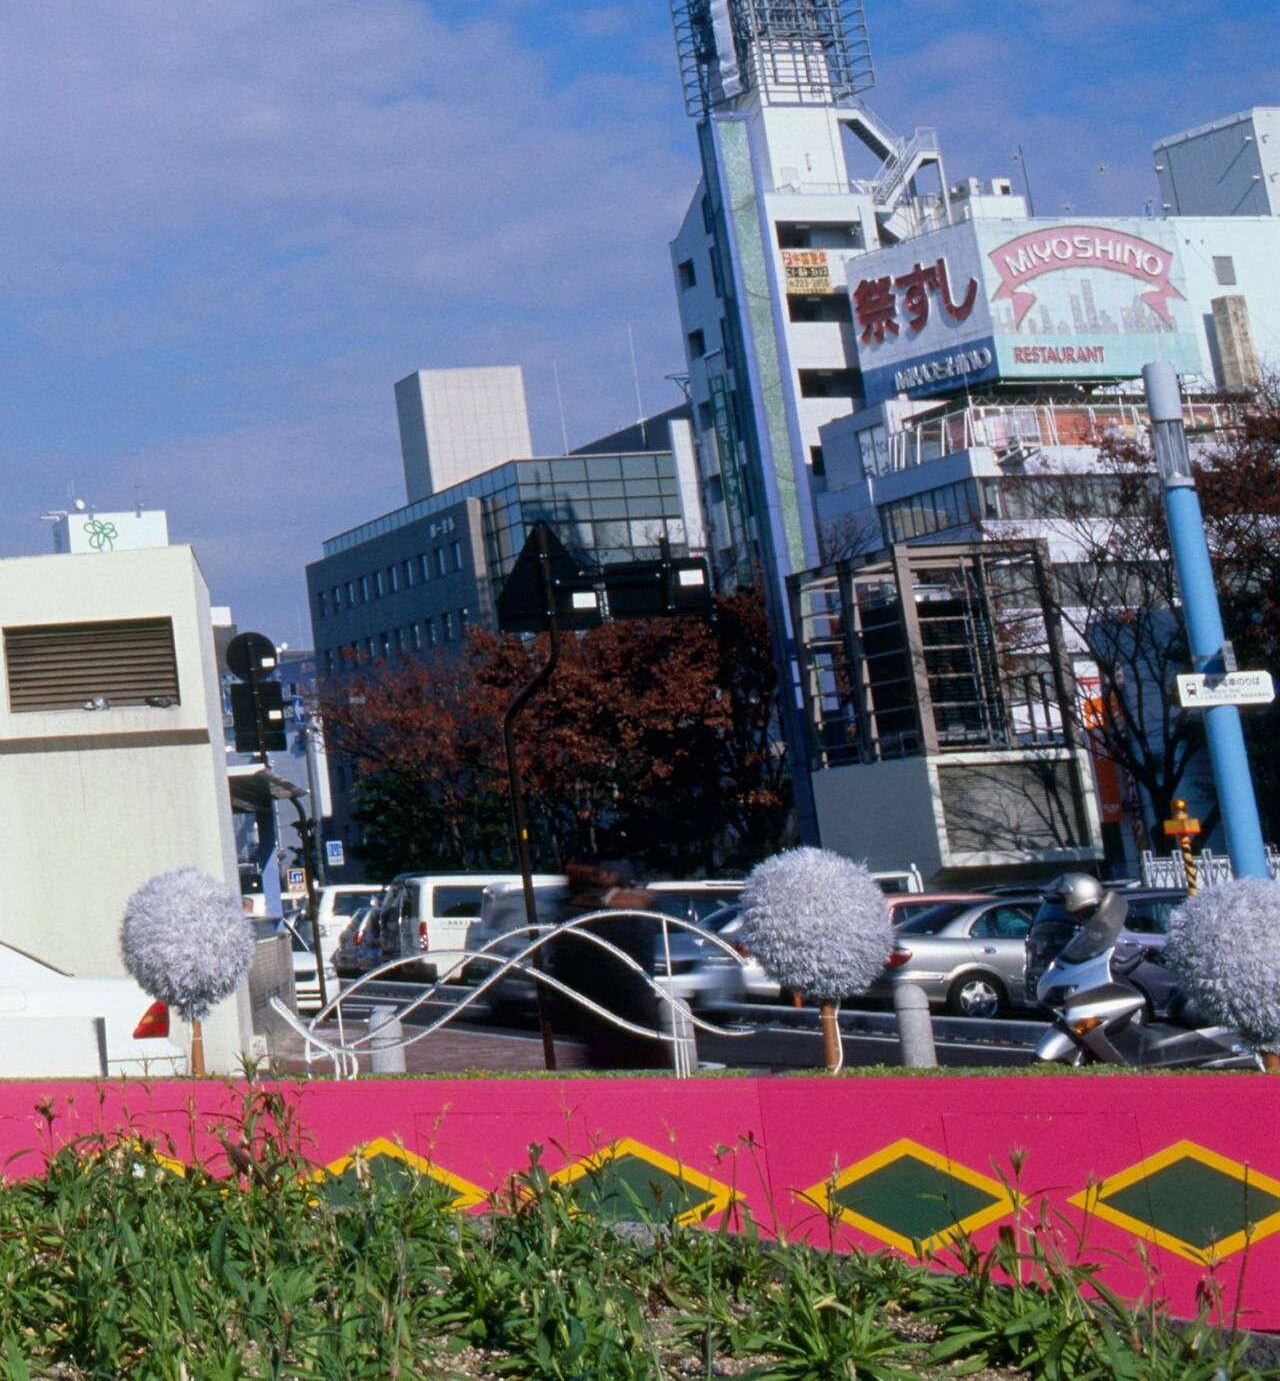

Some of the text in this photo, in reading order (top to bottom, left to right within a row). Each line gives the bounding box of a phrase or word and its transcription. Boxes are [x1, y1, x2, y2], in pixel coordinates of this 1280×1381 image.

[1003, 234, 1164, 277] MIYOSHINO
[853, 257, 979, 346] 祭ずし
[895, 348, 992, 391] MIYOSHINO
[1013, 345, 1105, 365] RESTAURANT
